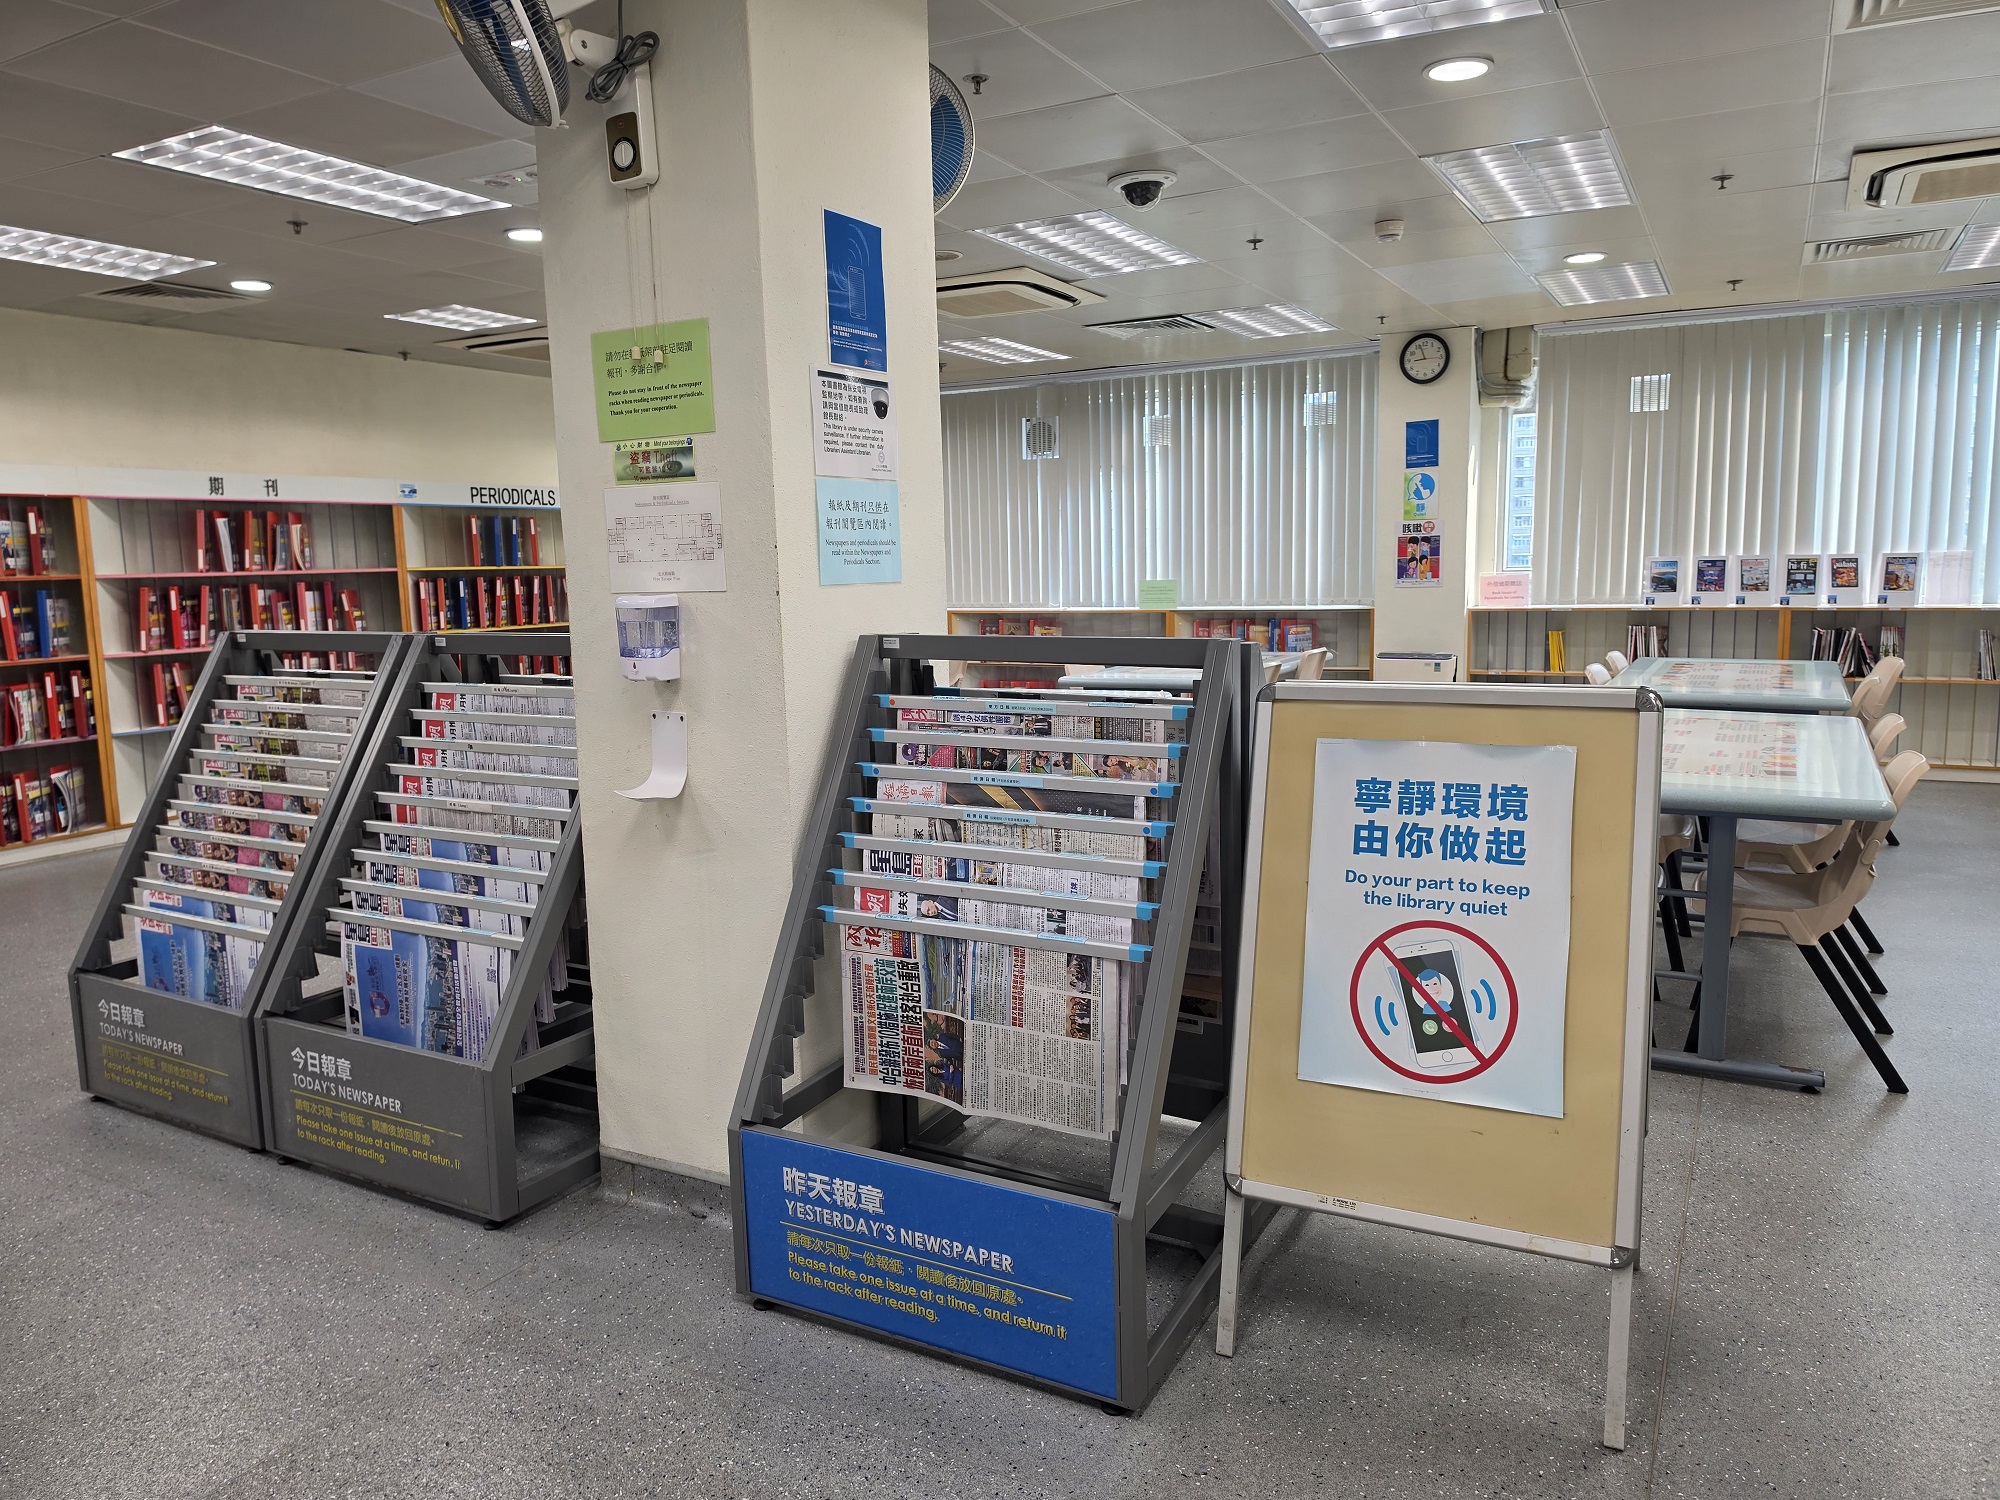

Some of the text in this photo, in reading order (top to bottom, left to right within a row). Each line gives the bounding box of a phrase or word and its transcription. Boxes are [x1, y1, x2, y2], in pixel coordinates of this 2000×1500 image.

[679, 381, 702, 389] newspaper
[633, 396, 649, 404] reading
[650, 395, 673, 403] newspaper
[630, 451, 651, 464] 盜竊
[654, 449, 677, 463] Theft
[208, 476, 279, 497] 期刊
[470, 486, 556, 506] PERIODICALS
[829, 499, 889, 513] 報紙及期刊只供在
[826, 517, 892, 530] 報刊閱覽區內閱讀。
[1403, 523, 1422, 533] 咳嗽
[825, 539, 849, 547] Newspapers
[861, 549, 883, 557] Newspapers
[884, 782, 934, 801] 經濟日報
[1354, 777, 1529, 822] 寧靜環境
[1352, 819, 1527, 866] 由你做起
[1345, 869, 1531, 900] Do your part to keep
[866, 892, 884, 912] 明
[1364, 891, 1508, 917] the library quiet
[98, 999, 145, 1028] 今日報章
[99, 1022, 183, 1056] TODAY'S NEWSPAPER
[290, 1047, 352, 1081] 今日報章
[104, 1059, 122, 1071] Please
[122, 1063, 136, 1076] take
[137, 1069, 148, 1079] one
[149, 1071, 163, 1085] issue
[164, 1078, 170, 1087] at
[192, 1085, 204, 1097] and
[205, 1090, 223, 1103] return
[104, 1071, 110, 1080] to
[111, 1073, 120, 1083] the
[121, 1076, 134, 1087] rack
[135, 1080, 149, 1092] after
[293, 1073, 402, 1114] TODAY'S NEWSPAPER
[296, 1115, 320, 1130] Please
[321, 1121, 338, 1136] take
[339, 1128, 353, 1140] one
[355, 1131, 373, 1145] issue
[375, 1137, 383, 1148] at
[412, 1148, 428, 1161] and
[297, 1128, 387, 1164] to the rack after reading.
[782, 1166, 885, 1216] 昨天報章
[785, 1199, 1015, 1275] YESTERDAY'S NEWSPAPER
[787, 1230, 1025, 1306] 請每次只取一份報紙，閱讀後放回原處。
[788, 1266, 940, 1323] to the rack after reading.
[788, 1250, 1068, 1341] Please take one issue at a time, and return it
